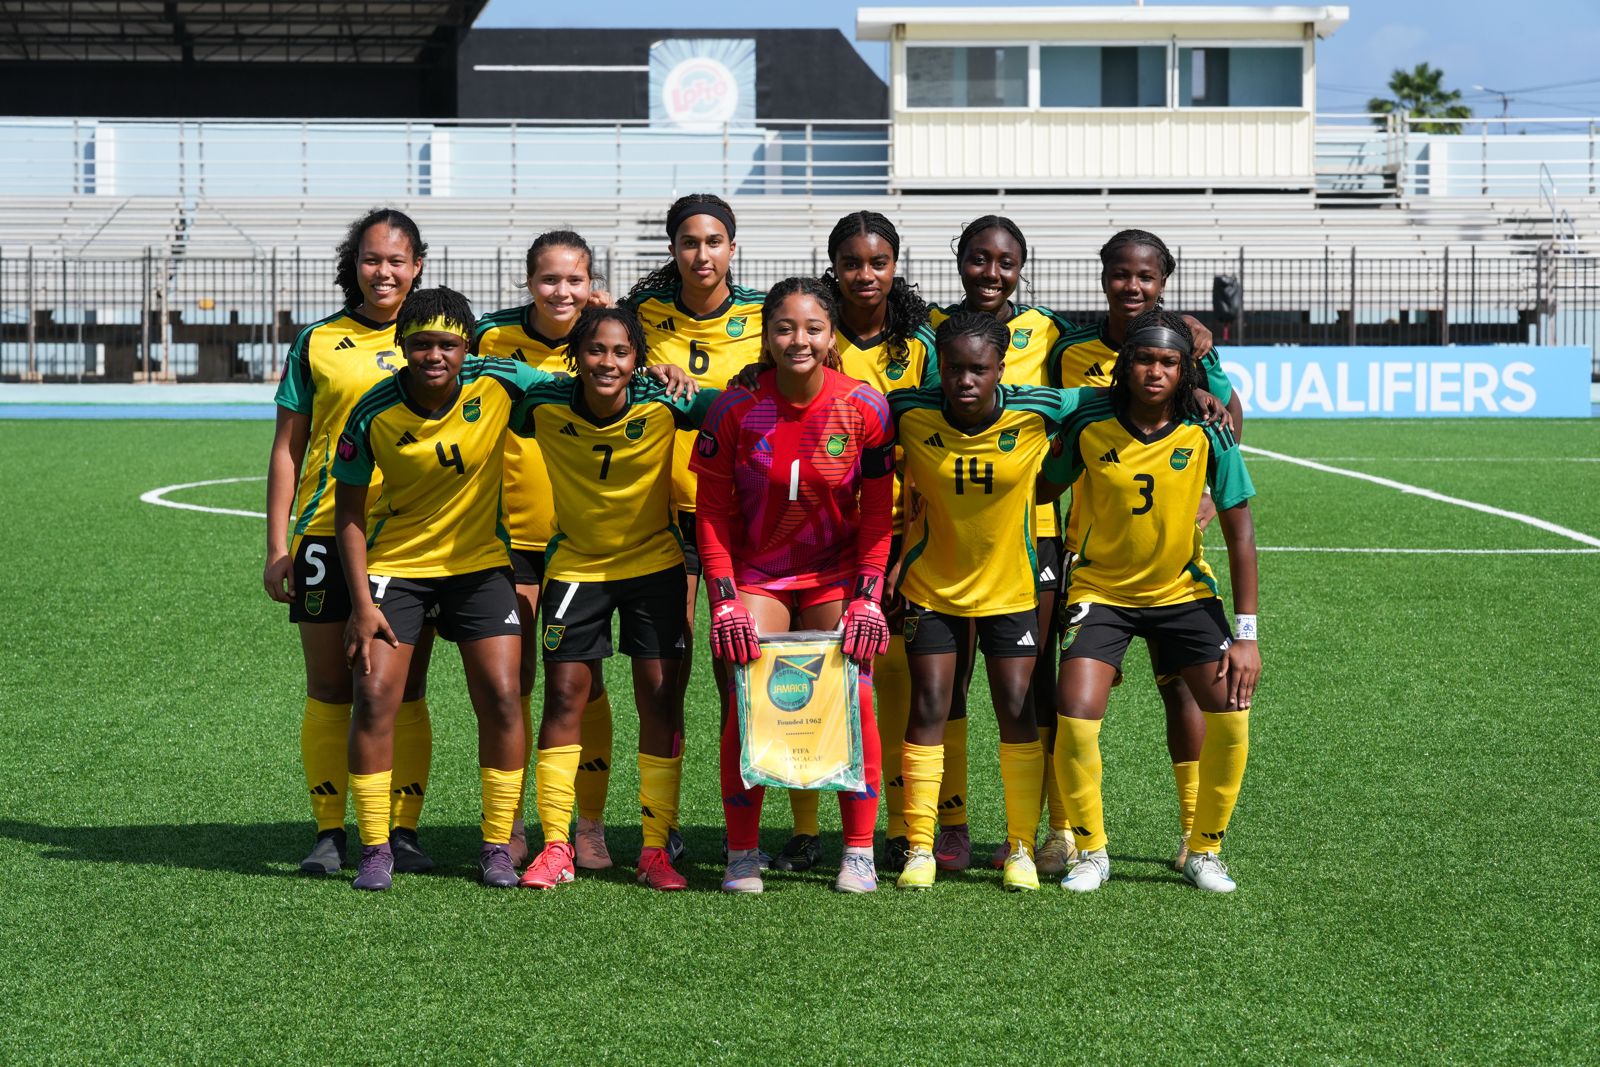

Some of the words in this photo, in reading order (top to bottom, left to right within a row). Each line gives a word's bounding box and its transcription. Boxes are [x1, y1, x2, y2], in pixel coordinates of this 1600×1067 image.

[689, 340, 710, 375] 6
[1222, 361, 1537, 413] QUALIFIERS
[435, 441, 465, 475] 4
[592, 444, 614, 480] 7
[955, 456, 994, 495] 14
[788, 459, 800, 500] 1
[1132, 473, 1154, 515] 3
[305, 543, 327, 585] 5
[554, 580, 580, 619] 7
[774, 683, 808, 694] JAMAICA
